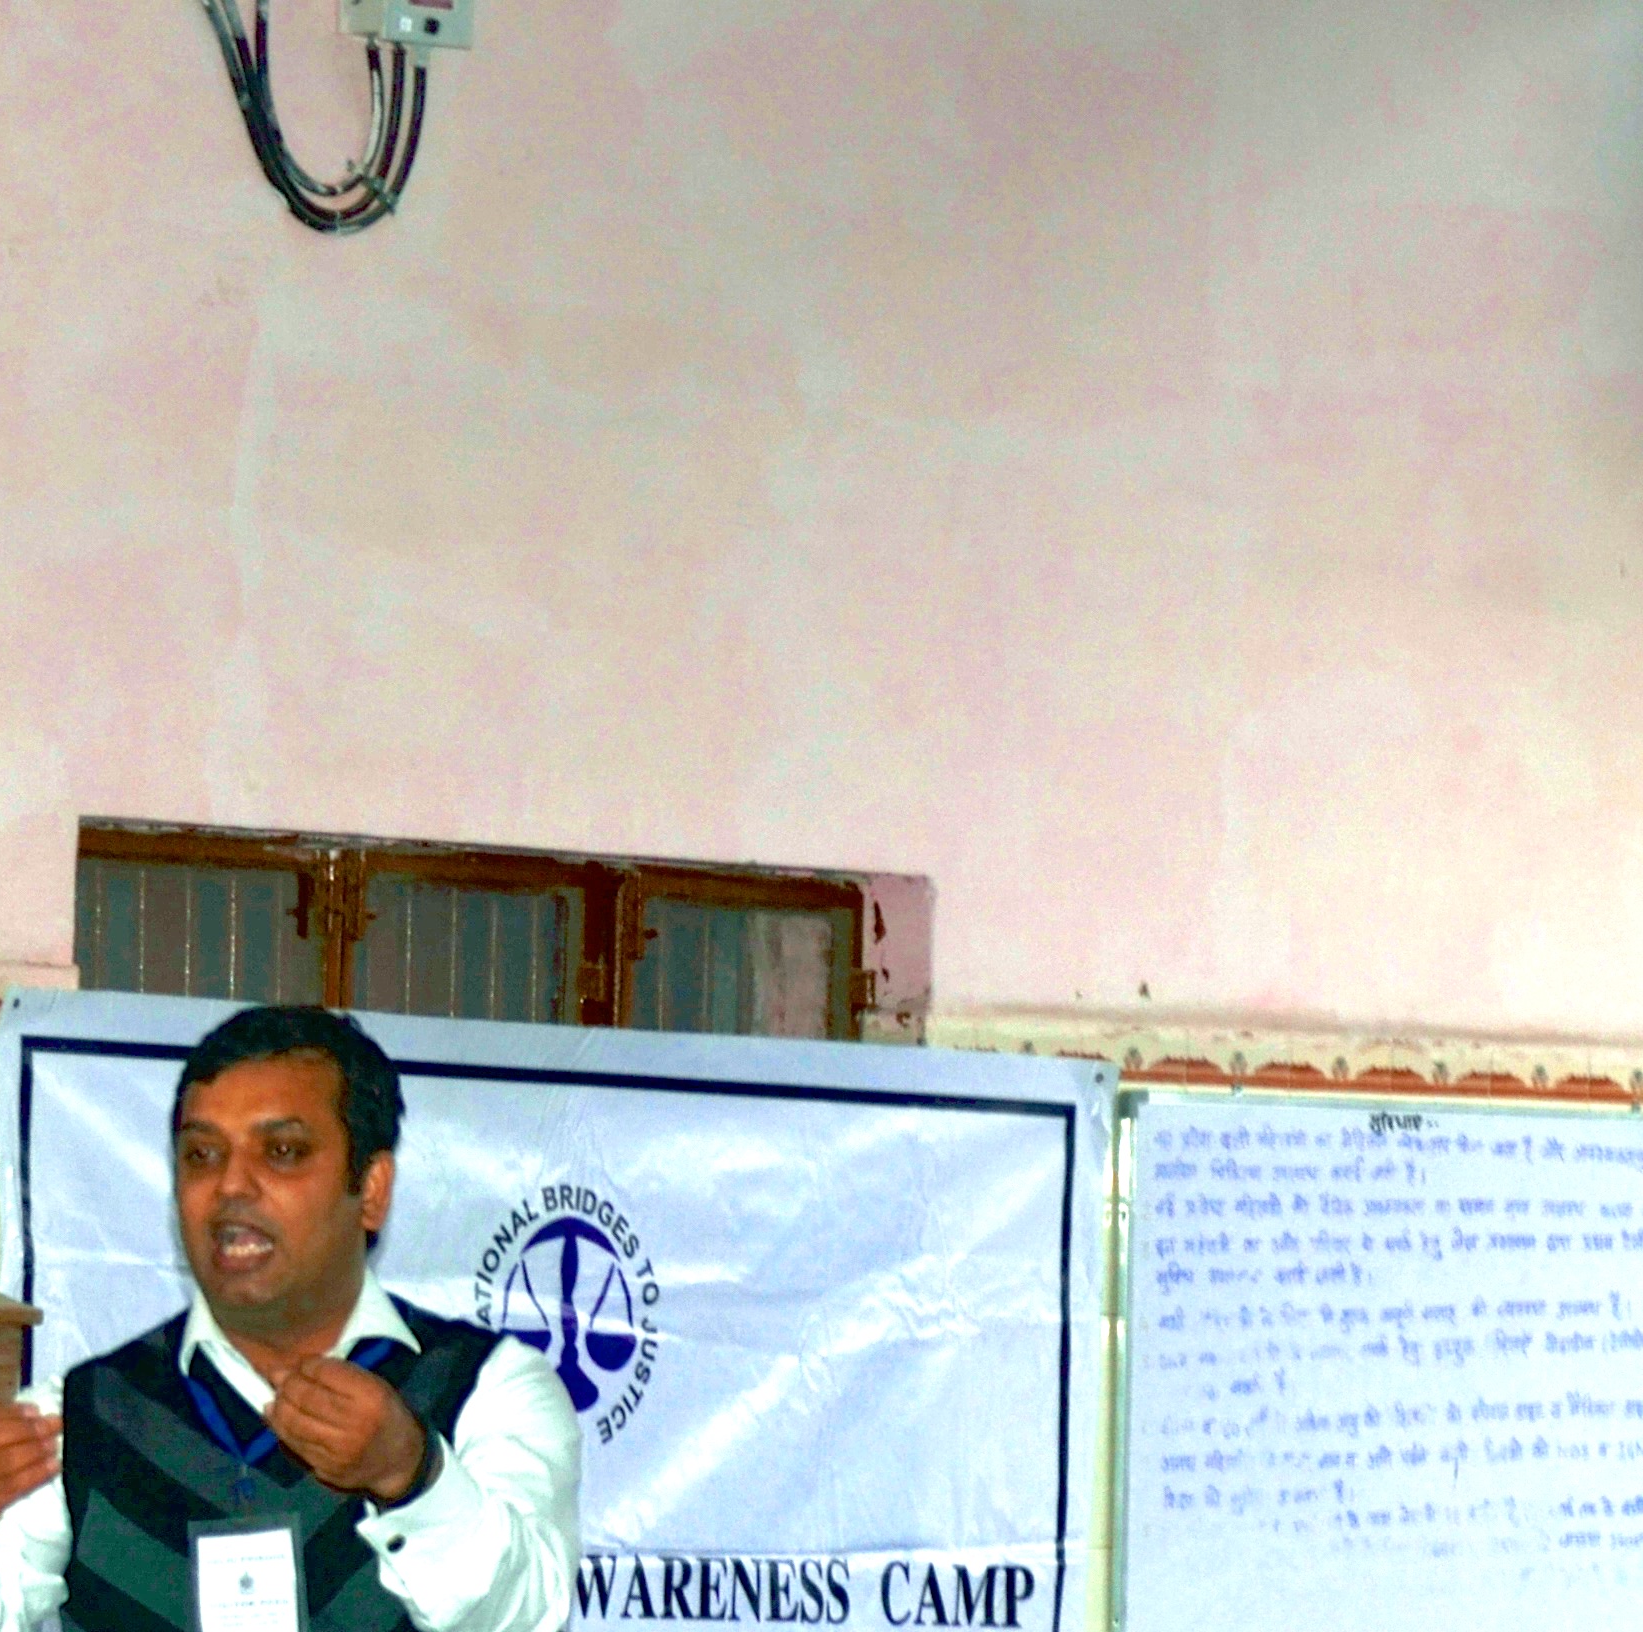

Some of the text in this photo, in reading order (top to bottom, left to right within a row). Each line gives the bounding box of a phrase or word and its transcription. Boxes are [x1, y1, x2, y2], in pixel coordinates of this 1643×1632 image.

[473, 1184, 660, 1444] ATIONAL BRIDGES TO JUSTICE
[576, 1553, 1036, 1629] WARENESS CAMP
